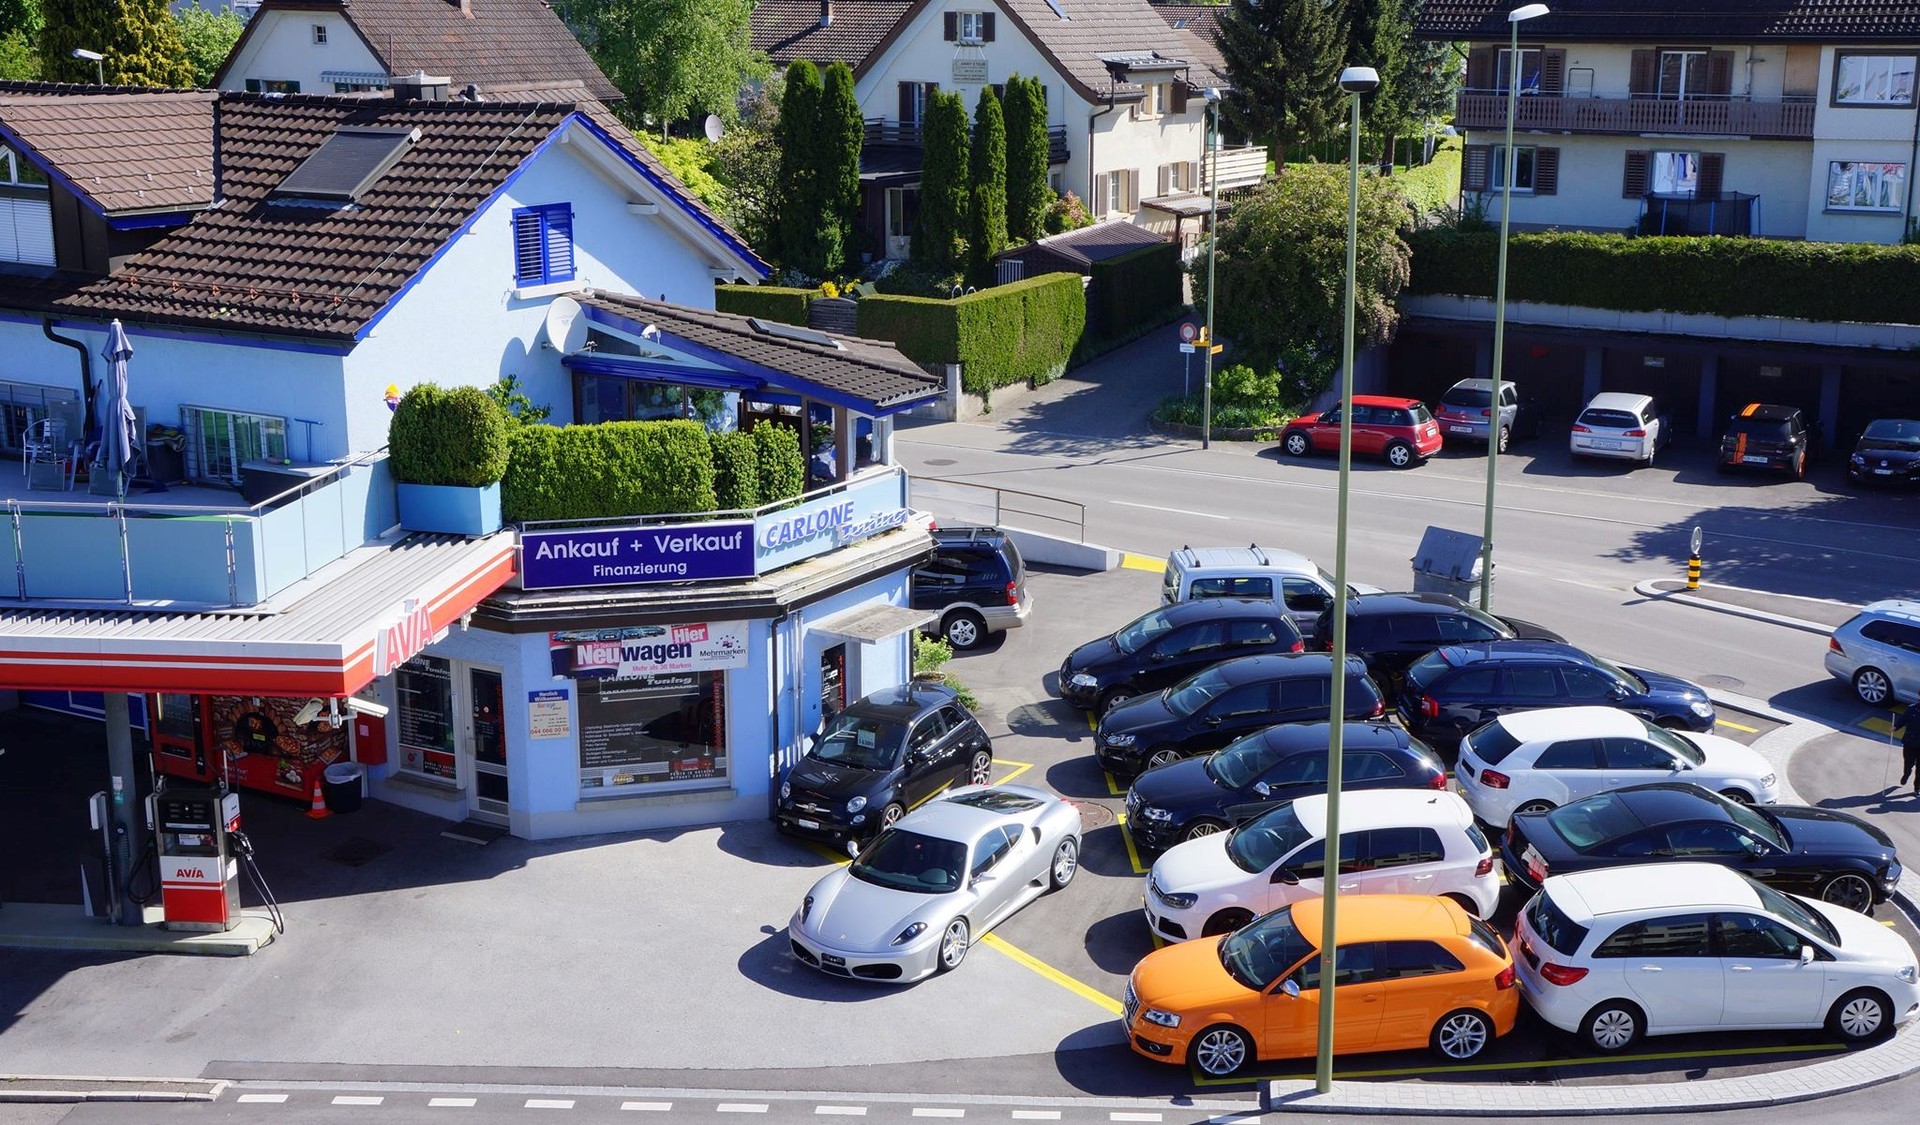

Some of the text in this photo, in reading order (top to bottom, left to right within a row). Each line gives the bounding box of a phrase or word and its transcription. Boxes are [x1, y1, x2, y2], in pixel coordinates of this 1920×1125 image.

[764, 500, 855, 548] CARLONE
[839, 509, 908, 540] Tuning
[535, 531, 743, 560] Ankauf + Verkauf
[593, 561, 687, 577] Finanzierung
[673, 626, 706, 643] Hier
[577, 641, 692, 665] Neuwagen
[700, 648, 746, 657] Mehrmarken
[632, 664, 648, 672] Mehr
[649, 663, 659, 671] als
[646, 676, 692, 685] Tuning
